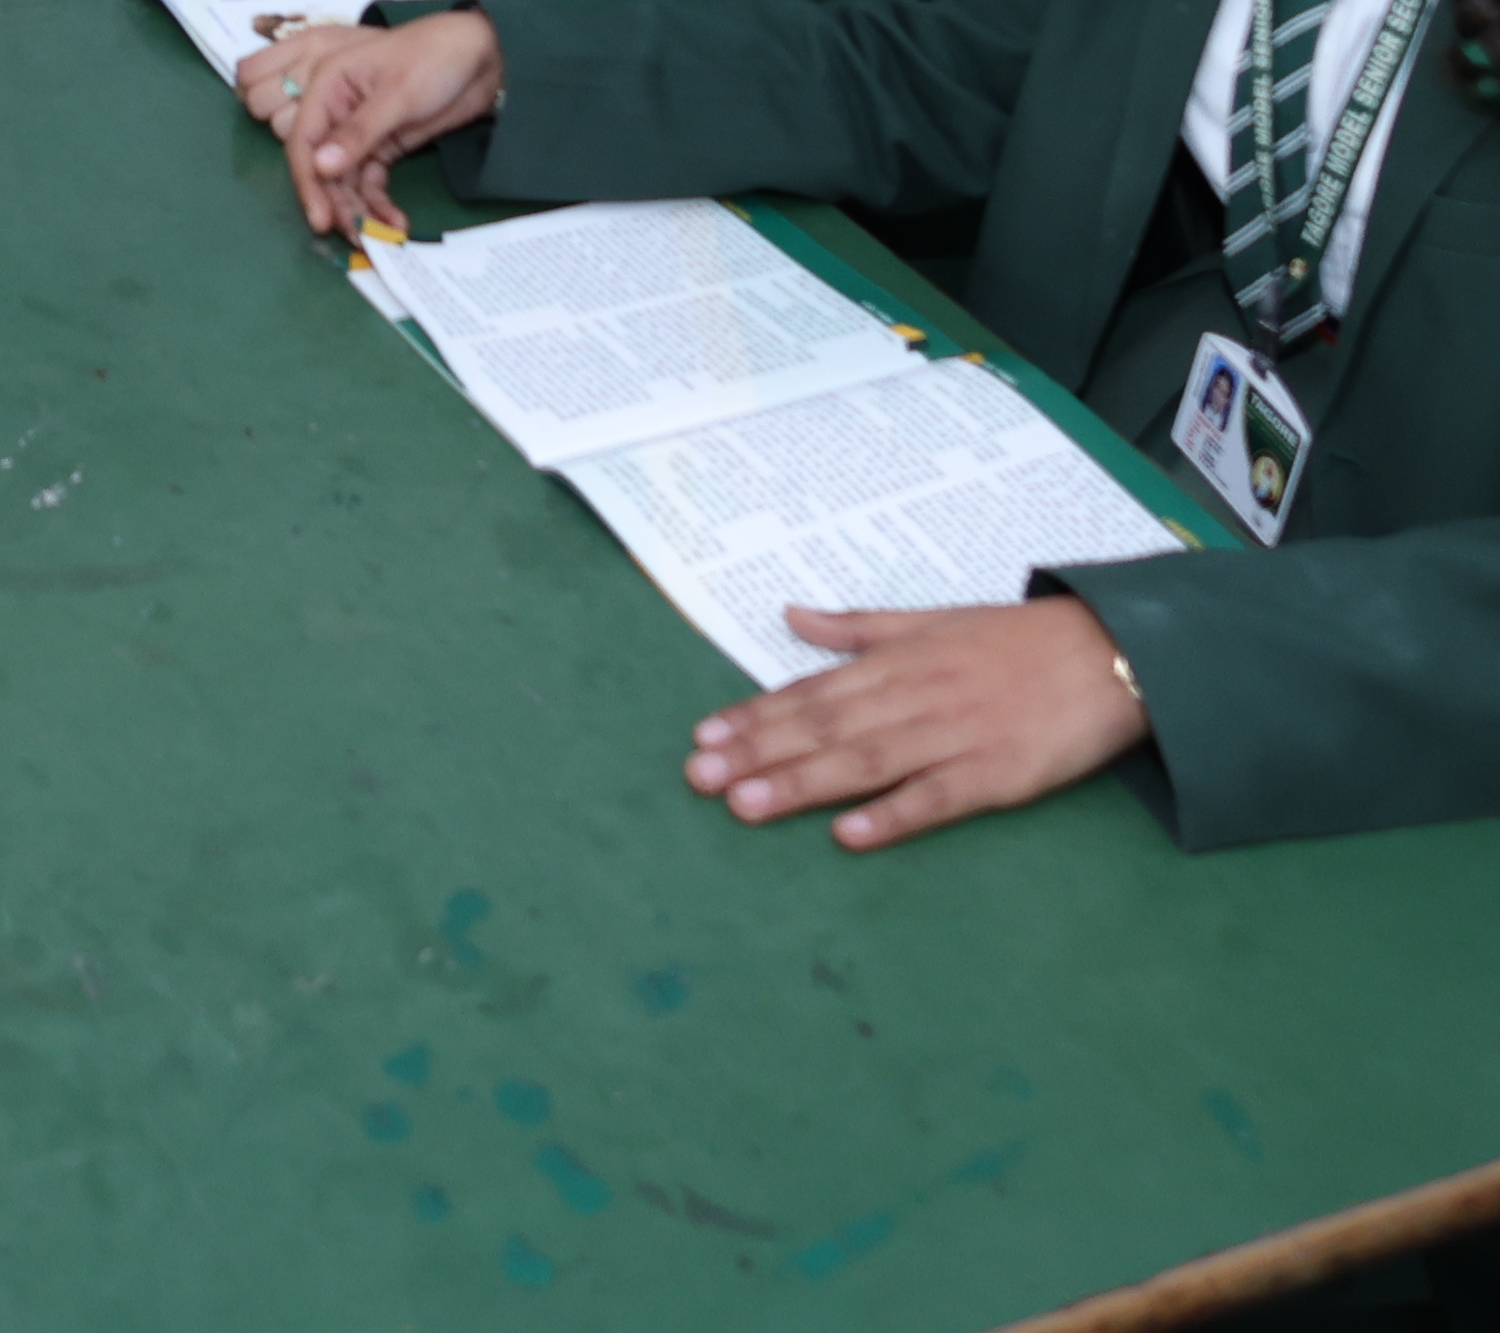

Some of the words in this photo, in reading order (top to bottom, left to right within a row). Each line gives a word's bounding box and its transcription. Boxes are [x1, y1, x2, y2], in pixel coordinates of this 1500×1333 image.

[1301, 173, 1343, 251] TAGORE
[1325, 108, 1373, 183] MODEL
[1352, 32, 1402, 109] SENIOR
